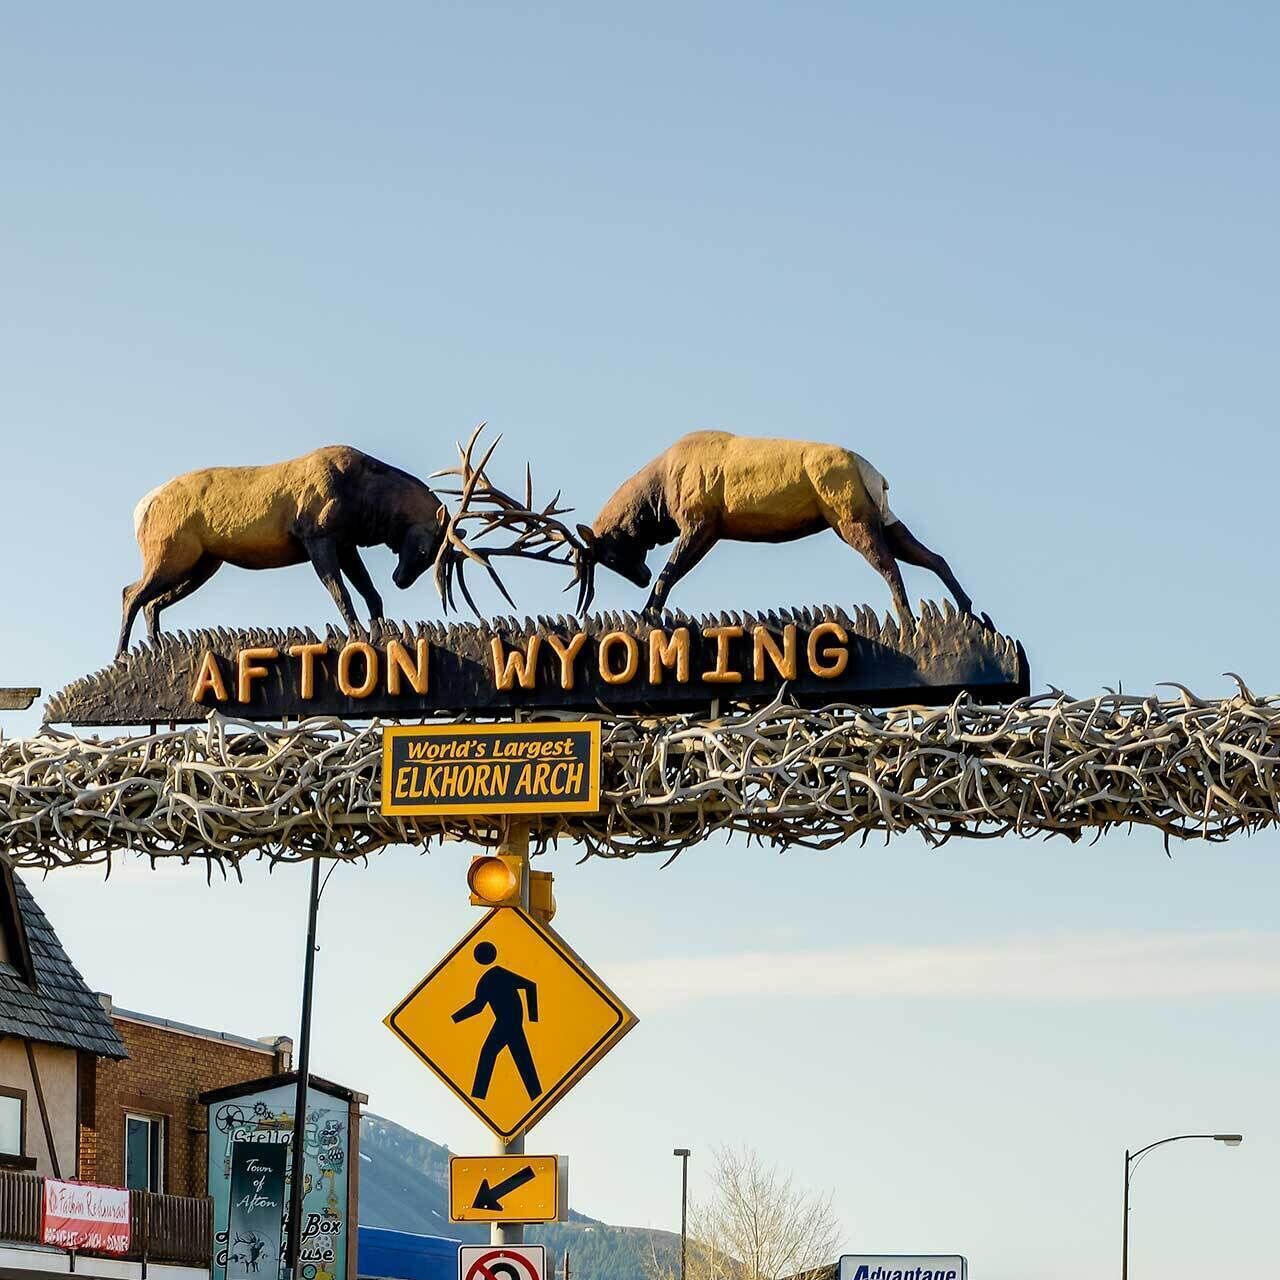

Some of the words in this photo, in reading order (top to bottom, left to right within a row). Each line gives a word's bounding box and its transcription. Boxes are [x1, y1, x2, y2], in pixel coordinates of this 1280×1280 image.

[192, 638, 428, 704] AFTON
[490, 622, 850, 692] WYOMING
[406, 740, 486, 760] World's
[491, 737, 574, 759] Largest
[395, 764, 510, 799] ELKHORN
[518, 760, 583, 797] ARCH
[246, 1158, 274, 1173] Town
[253, 1175, 265, 1192] of
[236, 1196, 278, 1214] Afton
[302, 1214, 343, 1243] Box
